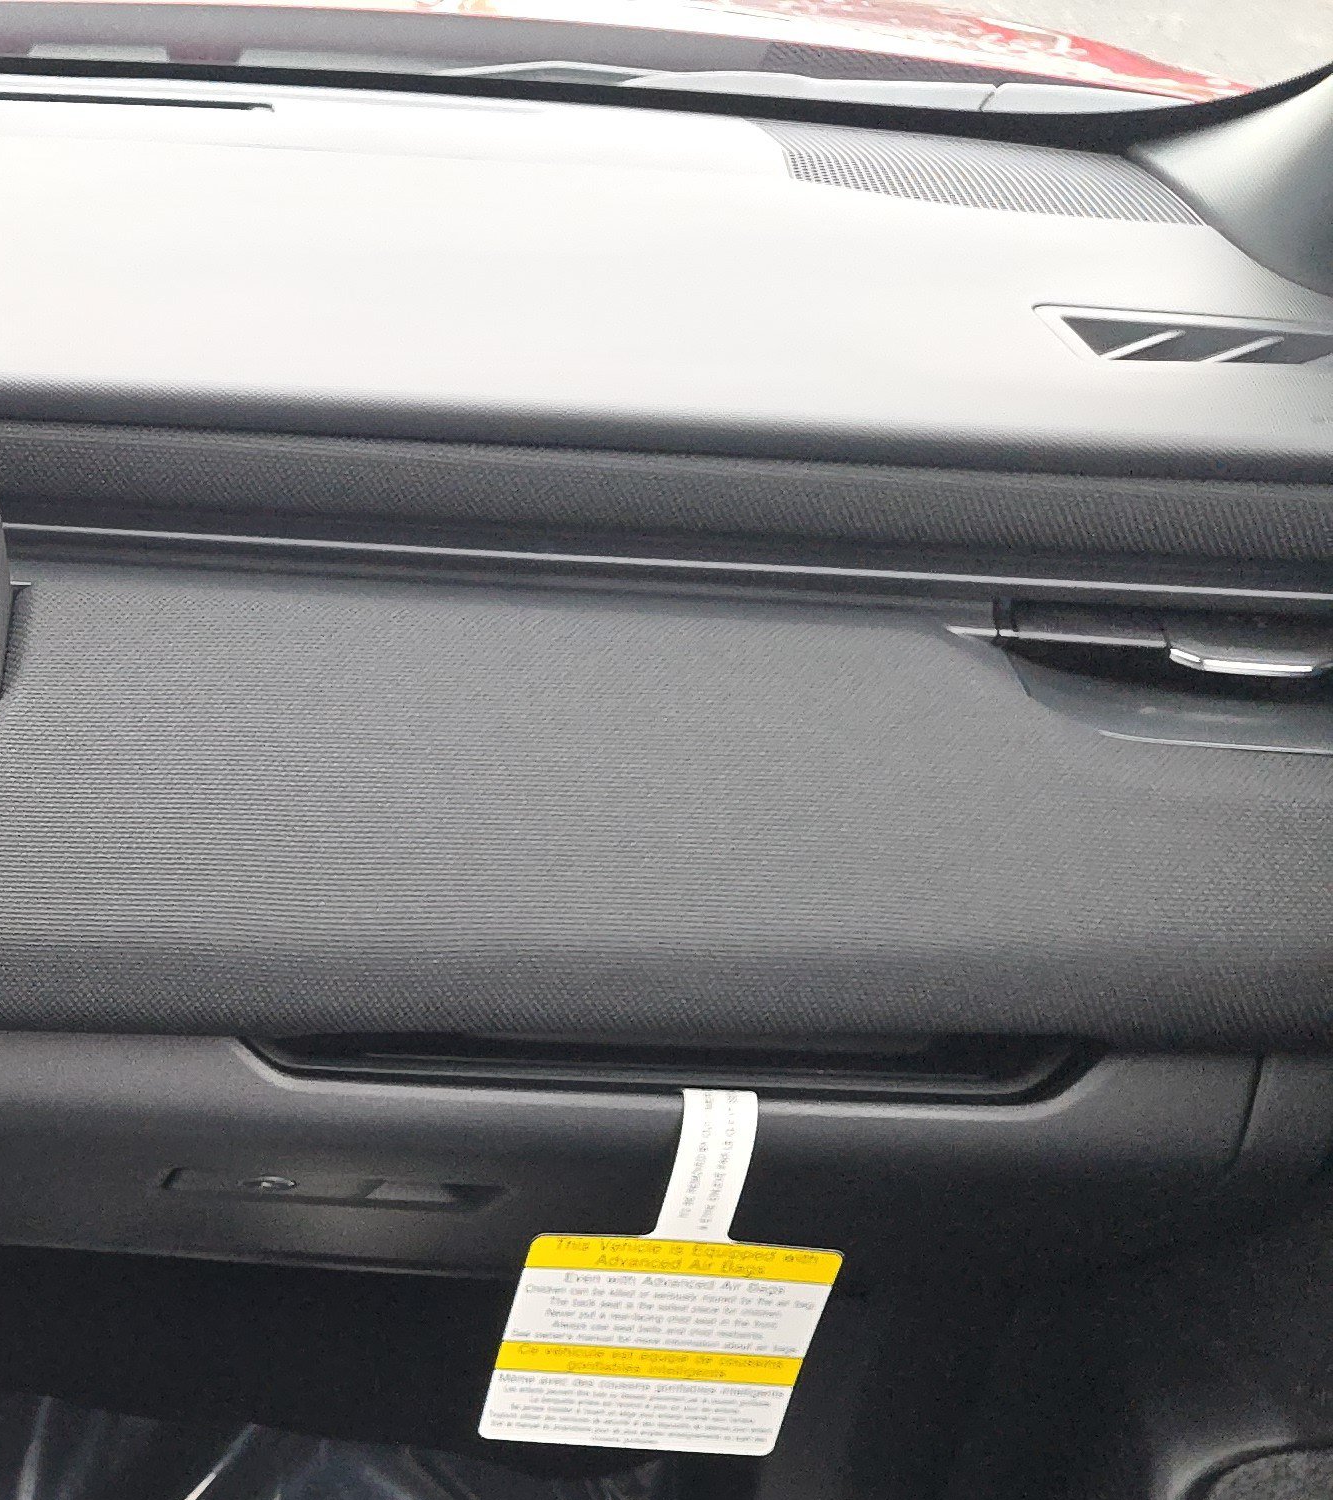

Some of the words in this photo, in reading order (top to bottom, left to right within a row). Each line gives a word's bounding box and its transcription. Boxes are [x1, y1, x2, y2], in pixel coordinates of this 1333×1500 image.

[555, 1238, 590, 1250] This
[599, 1240, 662, 1254] Vehicle
[668, 1245, 684, 1255] is
[690, 1246, 776, 1261] Equipped
[594, 1253, 681, 1270] Advanced
[688, 1258, 713, 1270] Air
[719, 1260, 767, 1277] Bags
